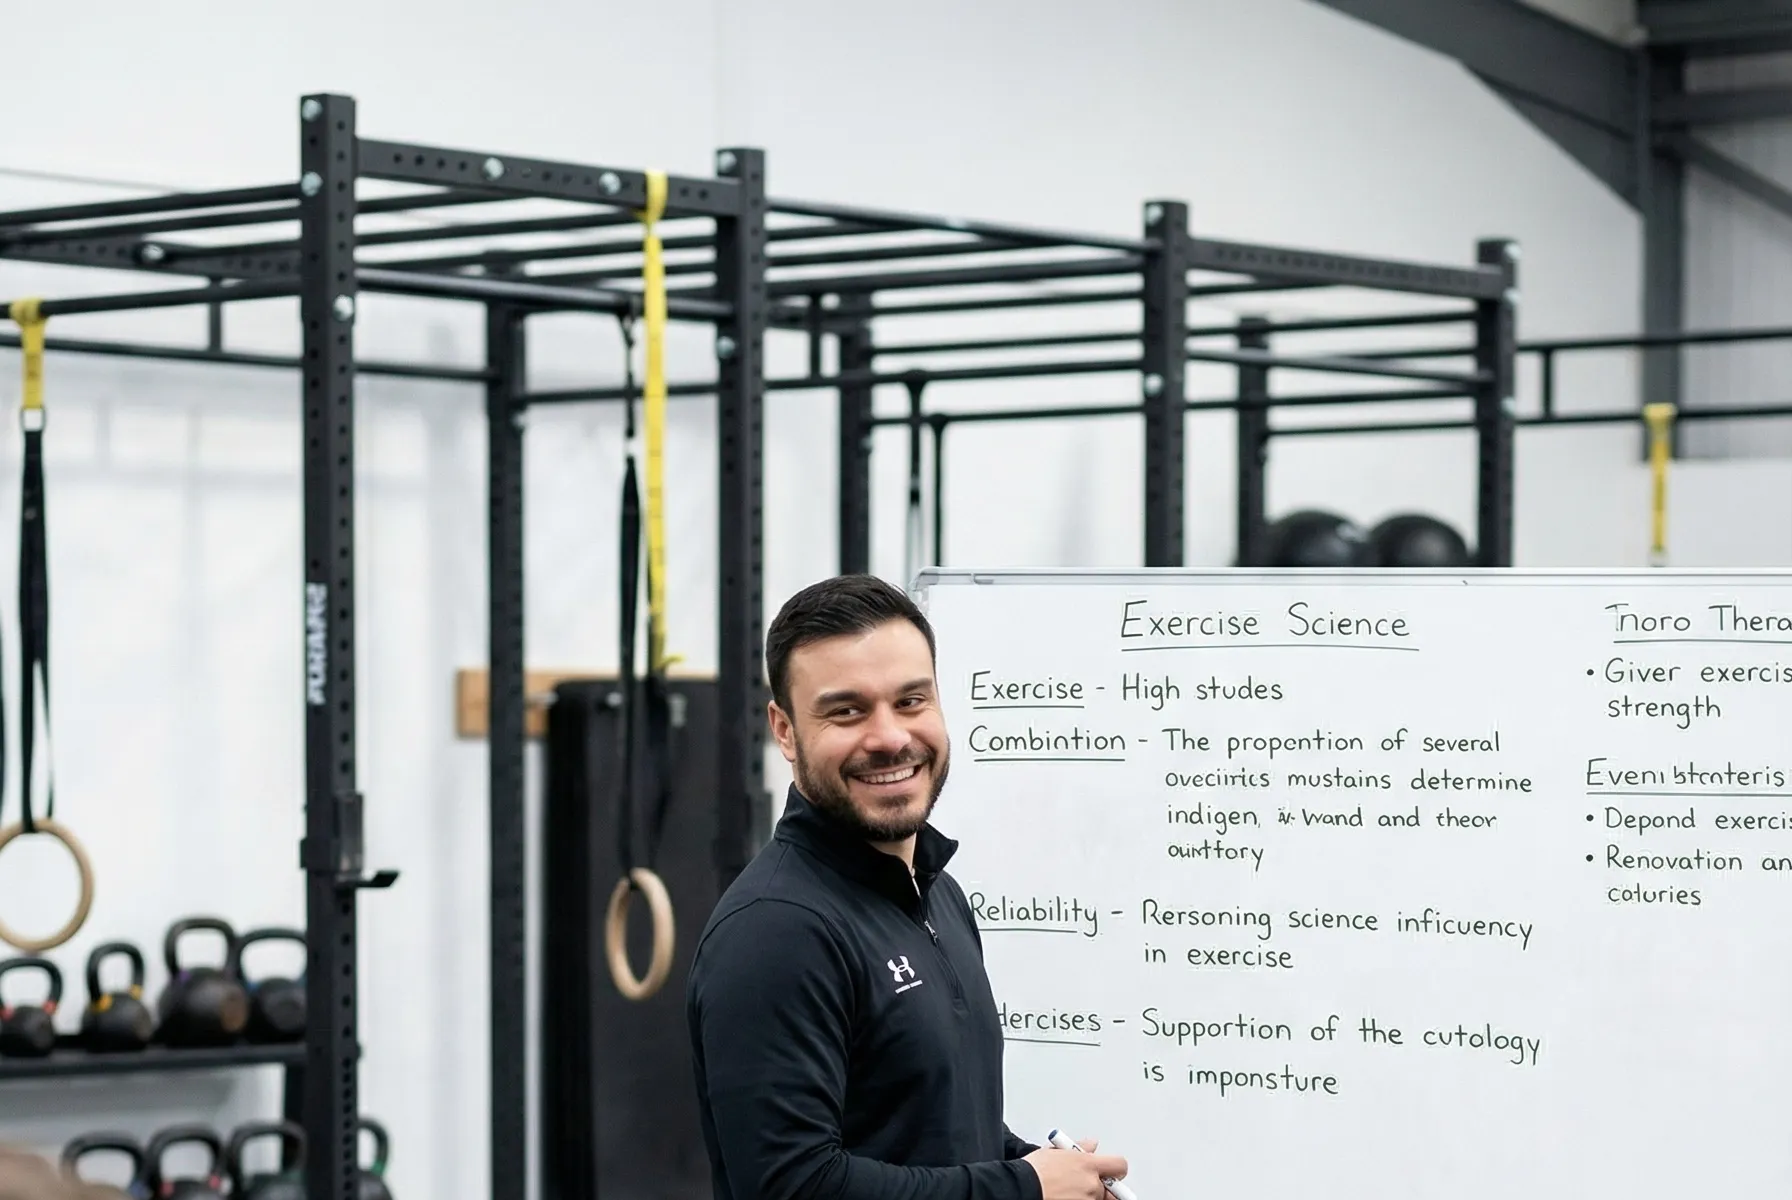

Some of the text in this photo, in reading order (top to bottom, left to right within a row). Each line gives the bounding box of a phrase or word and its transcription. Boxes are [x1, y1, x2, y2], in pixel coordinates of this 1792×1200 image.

[1120, 599, 1410, 638] Exercise Science
[1708, 604, 1792, 632] Thera
[1605, 657, 1681, 684] Giver
[971, 670, 1084, 701] Exercise
[1122, 672, 1180, 711] High
[1196, 675, 1283, 701] studes
[1608, 695, 1721, 730] strength
[968, 724, 1126, 753] Combintion
[1161, 728, 1211, 751] The
[1380, 727, 1409, 751] of
[1422, 730, 1500, 753] several
[1287, 766, 1392, 790] mustains
[1410, 767, 1532, 793] determine
[1377, 805, 1421, 828] and
[1604, 806, 1696, 836] Depond
[1606, 843, 1743, 871] Renovation
[968, 891, 1099, 938] Reliability
[1288, 907, 1379, 931] science
[1144, 943, 1295, 969] in exercise
[1142, 1007, 1292, 1047] Supportion
[1310, 1014, 1340, 1041] of
[1358, 1017, 1404, 1045] the
[1143, 1061, 1165, 1082] is
